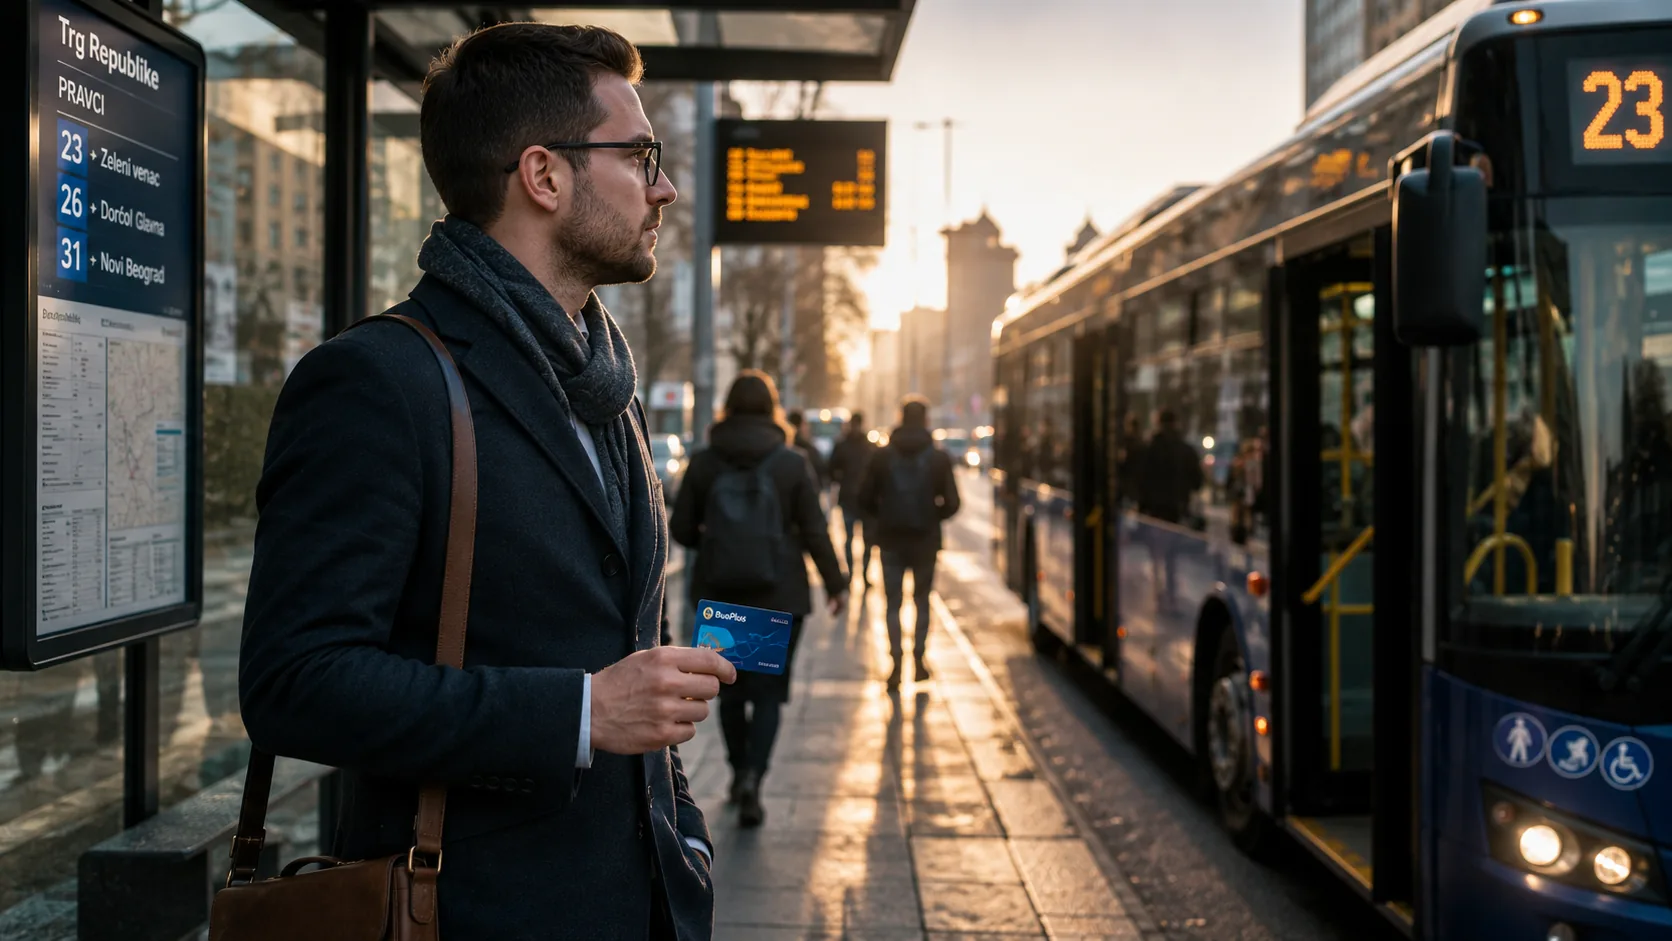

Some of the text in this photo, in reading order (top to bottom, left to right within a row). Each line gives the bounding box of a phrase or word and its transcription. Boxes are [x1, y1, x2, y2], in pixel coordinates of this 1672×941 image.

[57, 14, 160, 91] Trg Republike
[57, 75, 105, 116] PRAVCI
[1583, 70, 1664, 150] 23
[60, 128, 160, 188] 23 Zeleni venac
[60, 183, 83, 218] 26
[60, 237, 165, 285] 31 Novi Beograd
